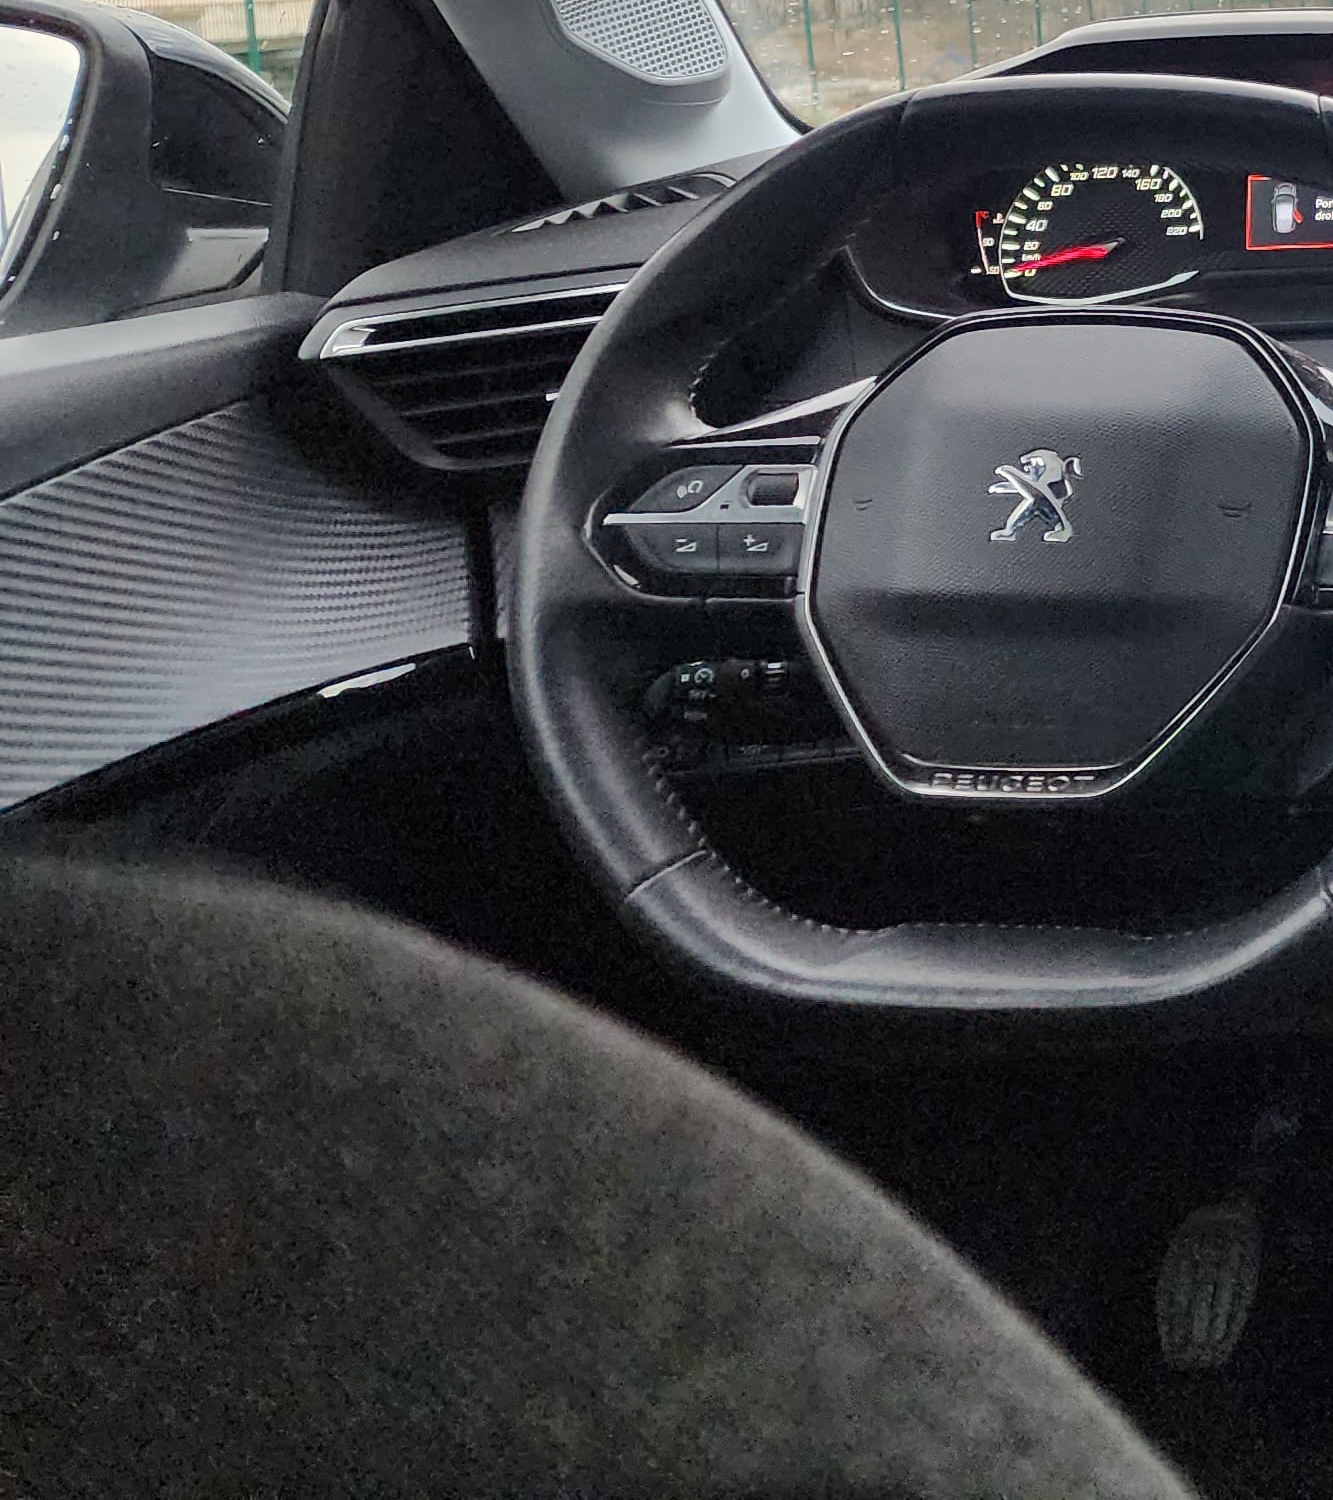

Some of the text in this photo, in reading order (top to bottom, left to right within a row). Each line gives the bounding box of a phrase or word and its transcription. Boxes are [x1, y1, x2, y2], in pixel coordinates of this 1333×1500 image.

[1069, 171, 1088, 181] 100
[1091, 166, 1119, 179] 120
[1122, 168, 1140, 179] 140
[1135, 177, 1163, 191] 160
[1050, 183, 1074, 197] 80
[1153, 193, 1173, 203] 180
[1037, 201, 1053, 211] 60
[1160, 208, 1182, 218] 200
[1025, 219, 1048, 232] 40
[1166, 226, 1188, 235] 220
[1023, 241, 1040, 251] 20
[932, 772, 1095, 792] PEUGEOT
